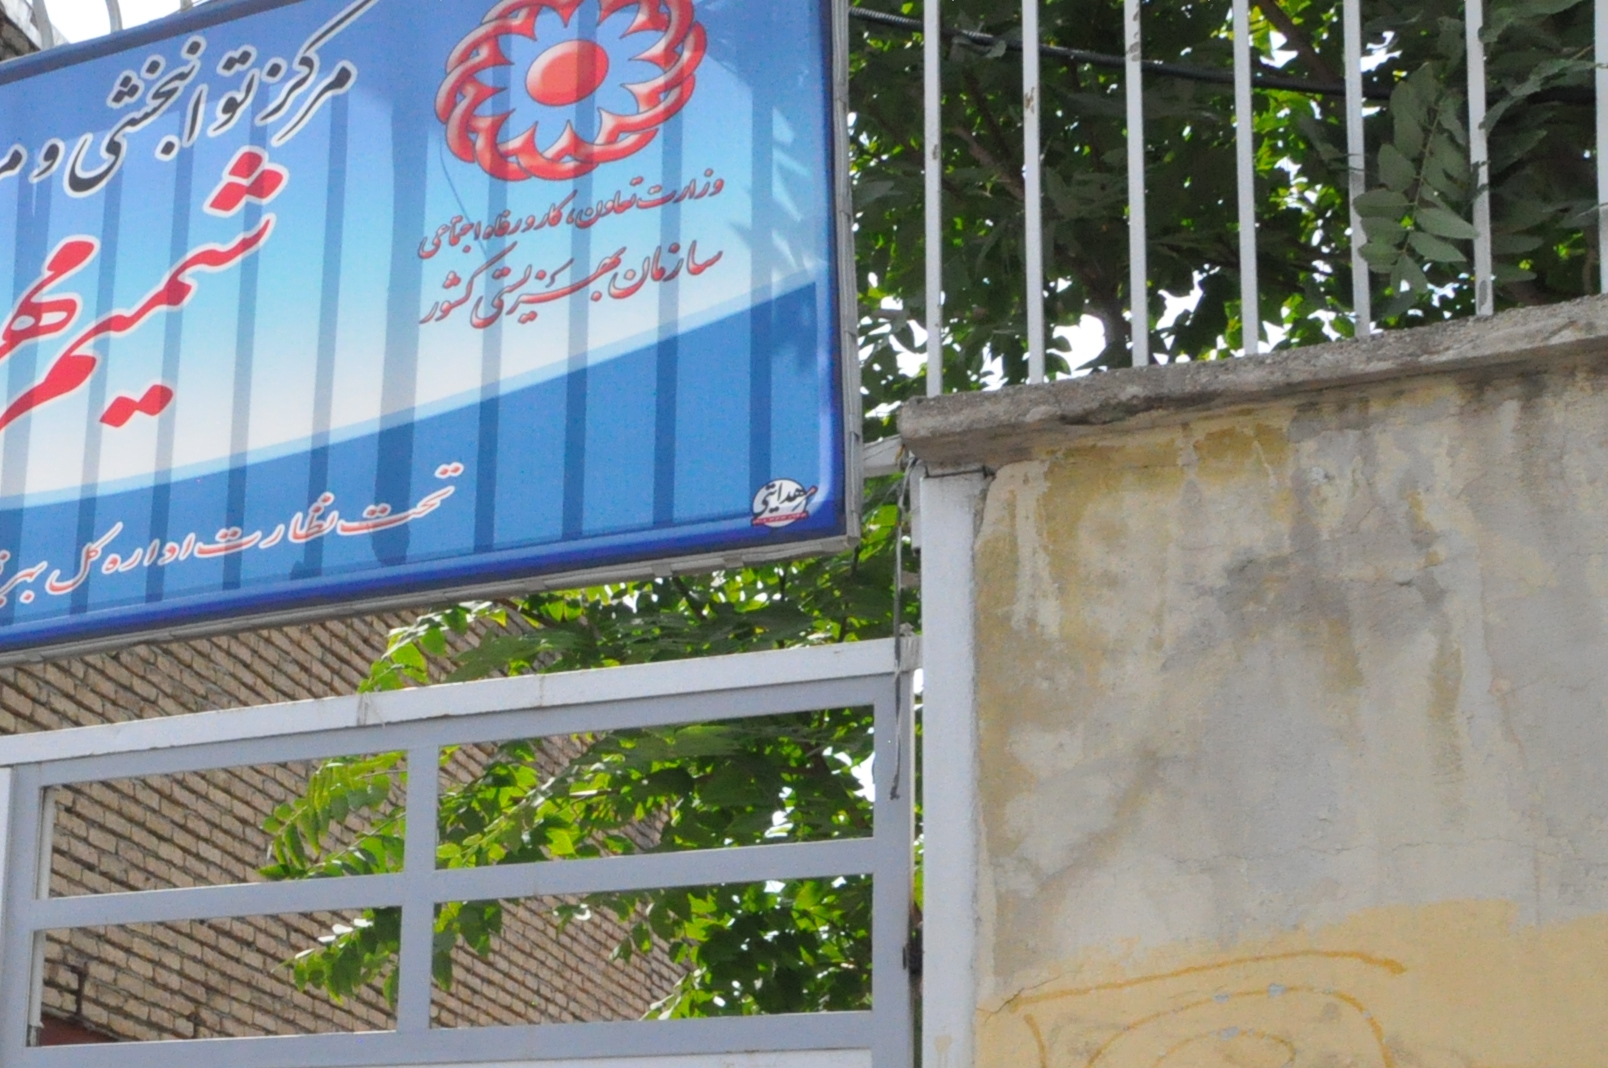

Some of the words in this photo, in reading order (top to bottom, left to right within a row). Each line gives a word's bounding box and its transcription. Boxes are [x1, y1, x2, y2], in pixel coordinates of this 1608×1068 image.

[255, 0, 378, 146] مرکز
[64, 36, 260, 196] توانبخشی
[30, 138, 63, 183] و
[636, 168, 725, 210] وزارت
[418, 215, 482, 259] اجتماعی
[483, 209, 521, 240] رفاه
[521, 215, 535, 232] و
[534, 189, 578, 230] کار
[419, 241, 518, 325] کشور
[470, 247, 627, 329] بهزیستی
[608, 240, 723, 299] سازمان
[194, 491, 339, 558] نظارت
[337, 462, 464, 535] تحت
[45, 521, 124, 597] کل
[102, 532, 196, 574] اداره
